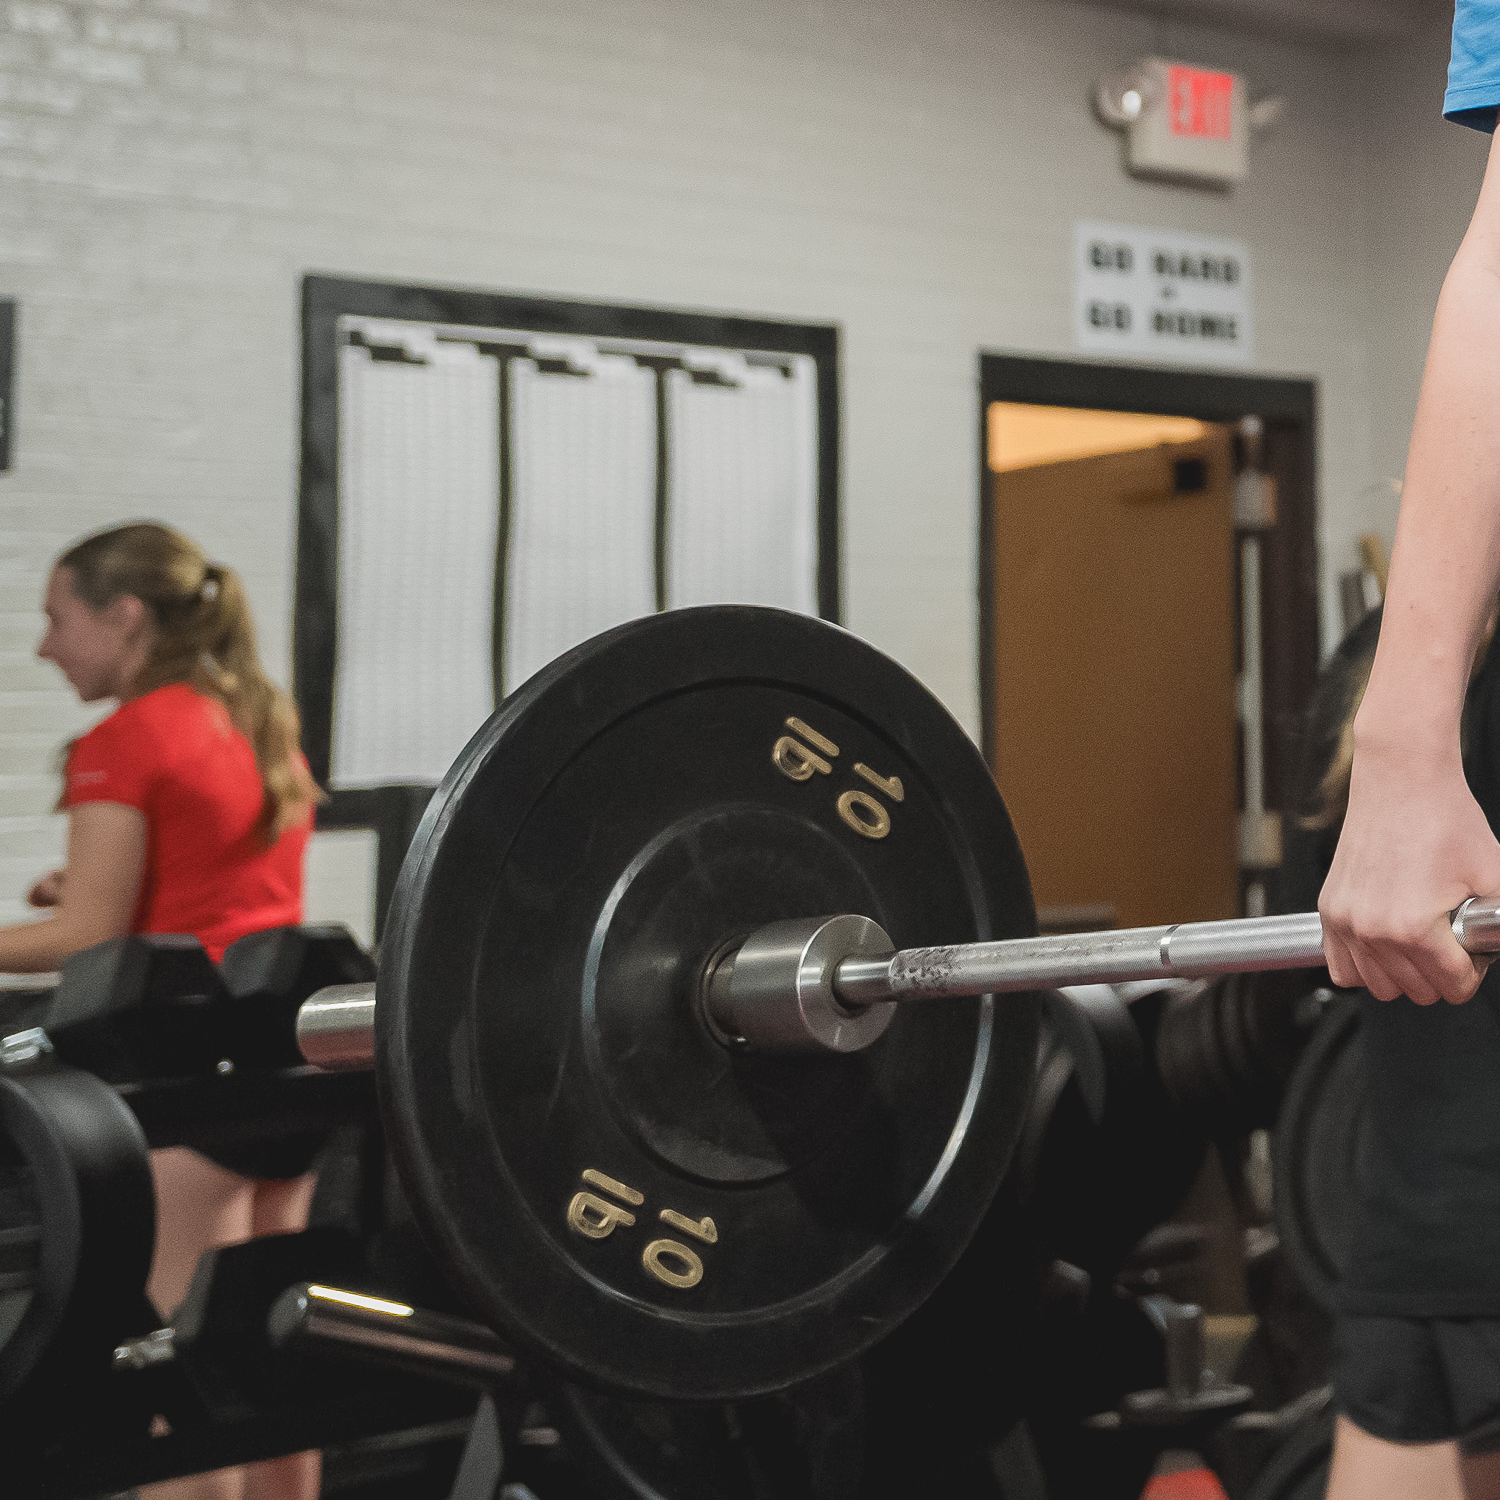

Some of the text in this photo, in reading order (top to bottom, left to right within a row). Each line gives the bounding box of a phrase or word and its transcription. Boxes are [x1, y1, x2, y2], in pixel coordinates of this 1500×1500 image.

[1088, 243, 1241, 288] GO HARD
[1087, 301, 1237, 343] GO HOME
[772, 716, 840, 781] lb
[836, 762, 904, 839] 10
[567, 1168, 644, 1239] lb
[643, 1208, 718, 1288] 10
